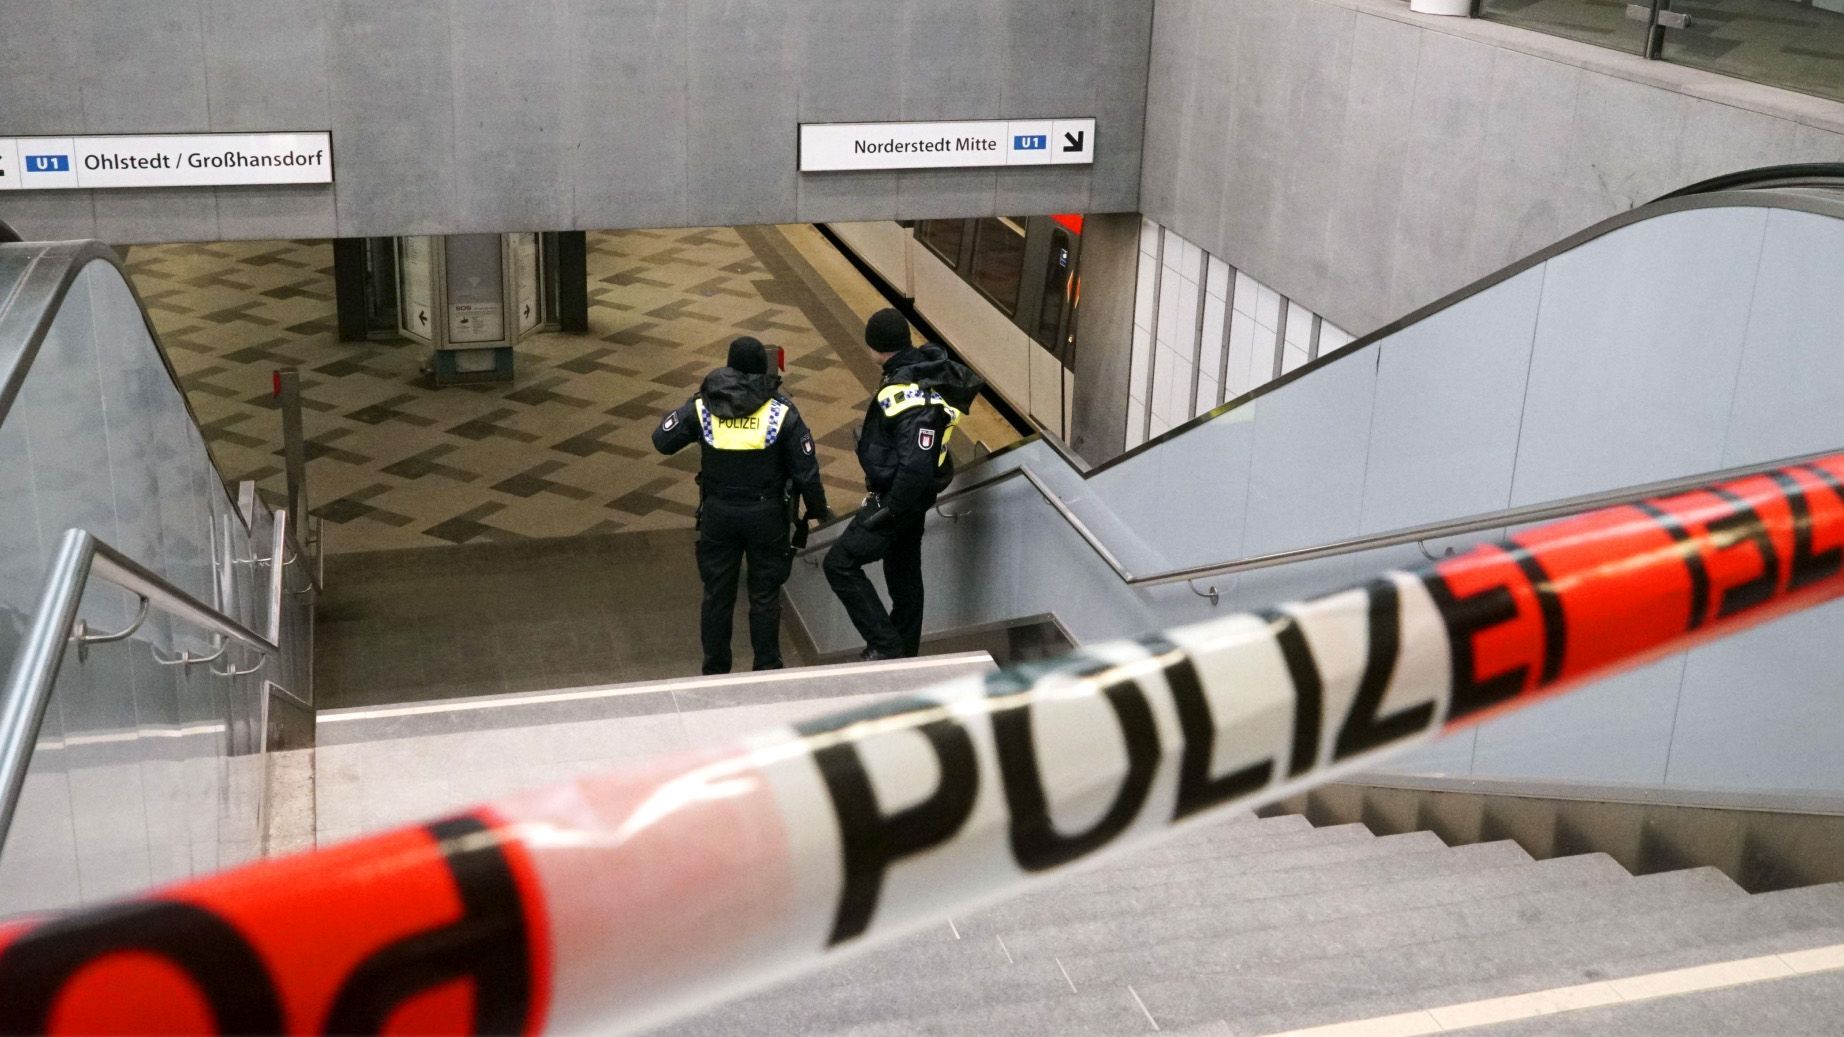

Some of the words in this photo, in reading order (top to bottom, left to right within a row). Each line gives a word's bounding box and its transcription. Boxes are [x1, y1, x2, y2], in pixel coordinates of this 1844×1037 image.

[854, 138, 951, 154] Norderstedt
[955, 137, 997, 152] Mitte
[1021, 137, 1039, 149] U1
[36, 157, 60, 170] U1
[84, 153, 171, 170] Ohlstedt
[176, 153, 182, 169] /
[188, 149, 323, 169] Großhansdorf
[719, 416, 760, 430] POLIZEI
[796, 538, 1568, 948] POLIZEI
